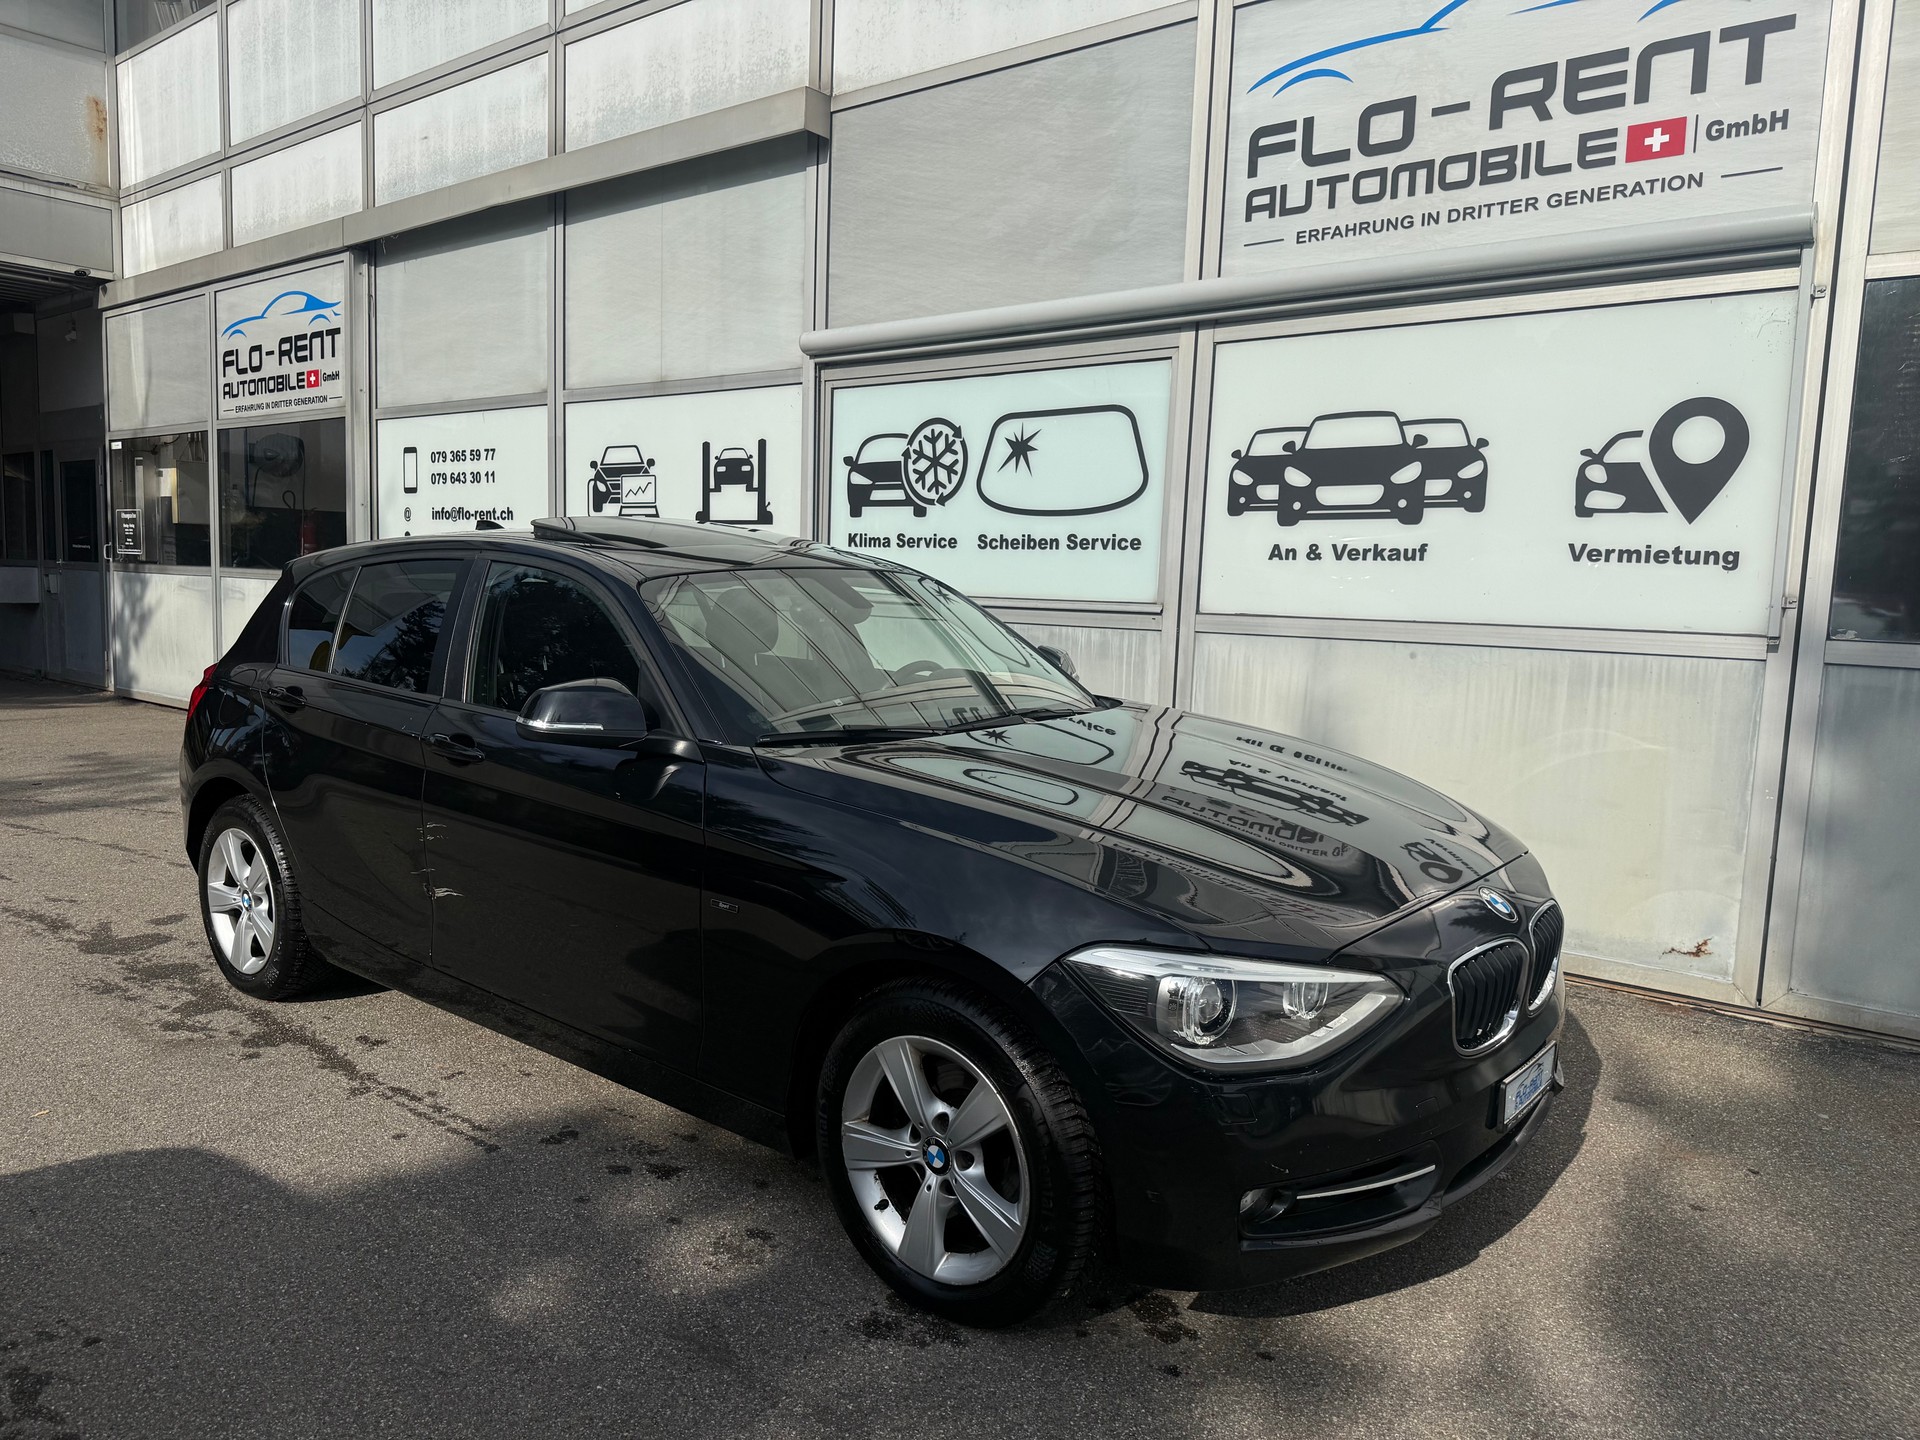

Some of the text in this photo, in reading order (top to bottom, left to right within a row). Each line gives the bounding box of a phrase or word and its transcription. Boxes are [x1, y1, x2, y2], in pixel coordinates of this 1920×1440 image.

[1248, 13, 1797, 180] FLO-RENT
[1245, 108, 1790, 223] AUTOMOBILE GmbH
[1295, 171, 1704, 245] ERFAHRUNG IN DRITTER GENERATION
[222, 326, 342, 379] FLO-RENT
[222, 370, 340, 400] AUTOMOBILE GmbH
[235, 394, 328, 414] ERFAHRUNG IN DRITTER GENERATION
[430, 447, 496, 464] 079 365 59 77
[430, 470, 496, 485] 079 643 30 11
[431, 506, 514, 522] info@flo-rent.ch
[847, 532, 958, 549] Klima Service
[977, 533, 1142, 551] Scheiben Service
[1267, 543, 1429, 562] An & Verkauf
[1568, 543, 1740, 571] Vermietung
